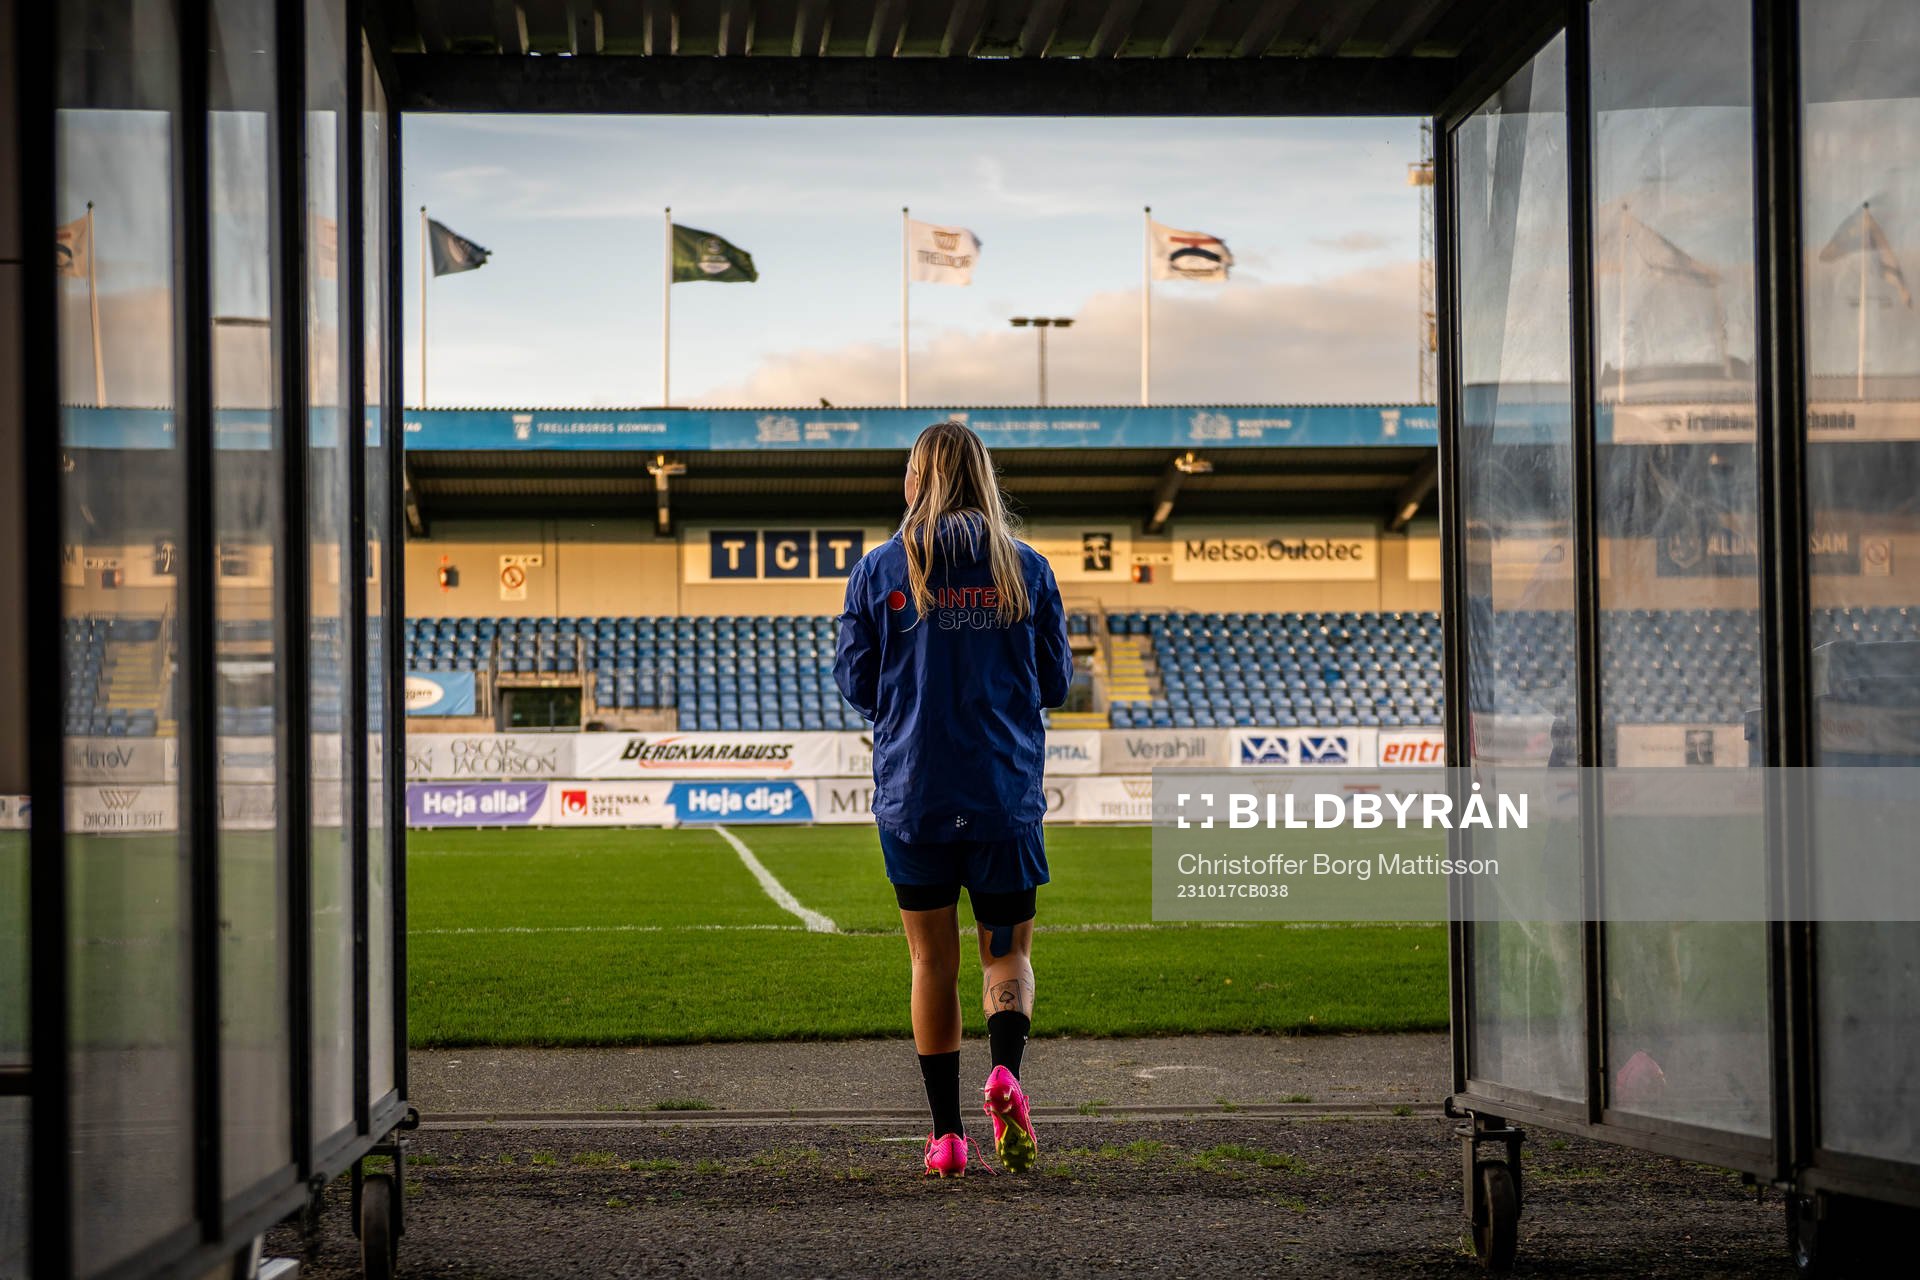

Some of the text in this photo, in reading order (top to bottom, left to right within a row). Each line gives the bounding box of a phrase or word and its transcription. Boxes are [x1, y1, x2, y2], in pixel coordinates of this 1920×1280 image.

[536, 422, 615, 434] TRELLEBORGS
[937, 586, 999, 609] INTE
[1125, 735, 1206, 759] Verahill
[453, 754, 557, 775] JACOBSON
[423, 789, 528, 818] Heja alla!
[592, 793, 650, 806] SVENSKA
[688, 787, 793, 816] Heja dig!
[592, 805, 623, 817] SPEL
